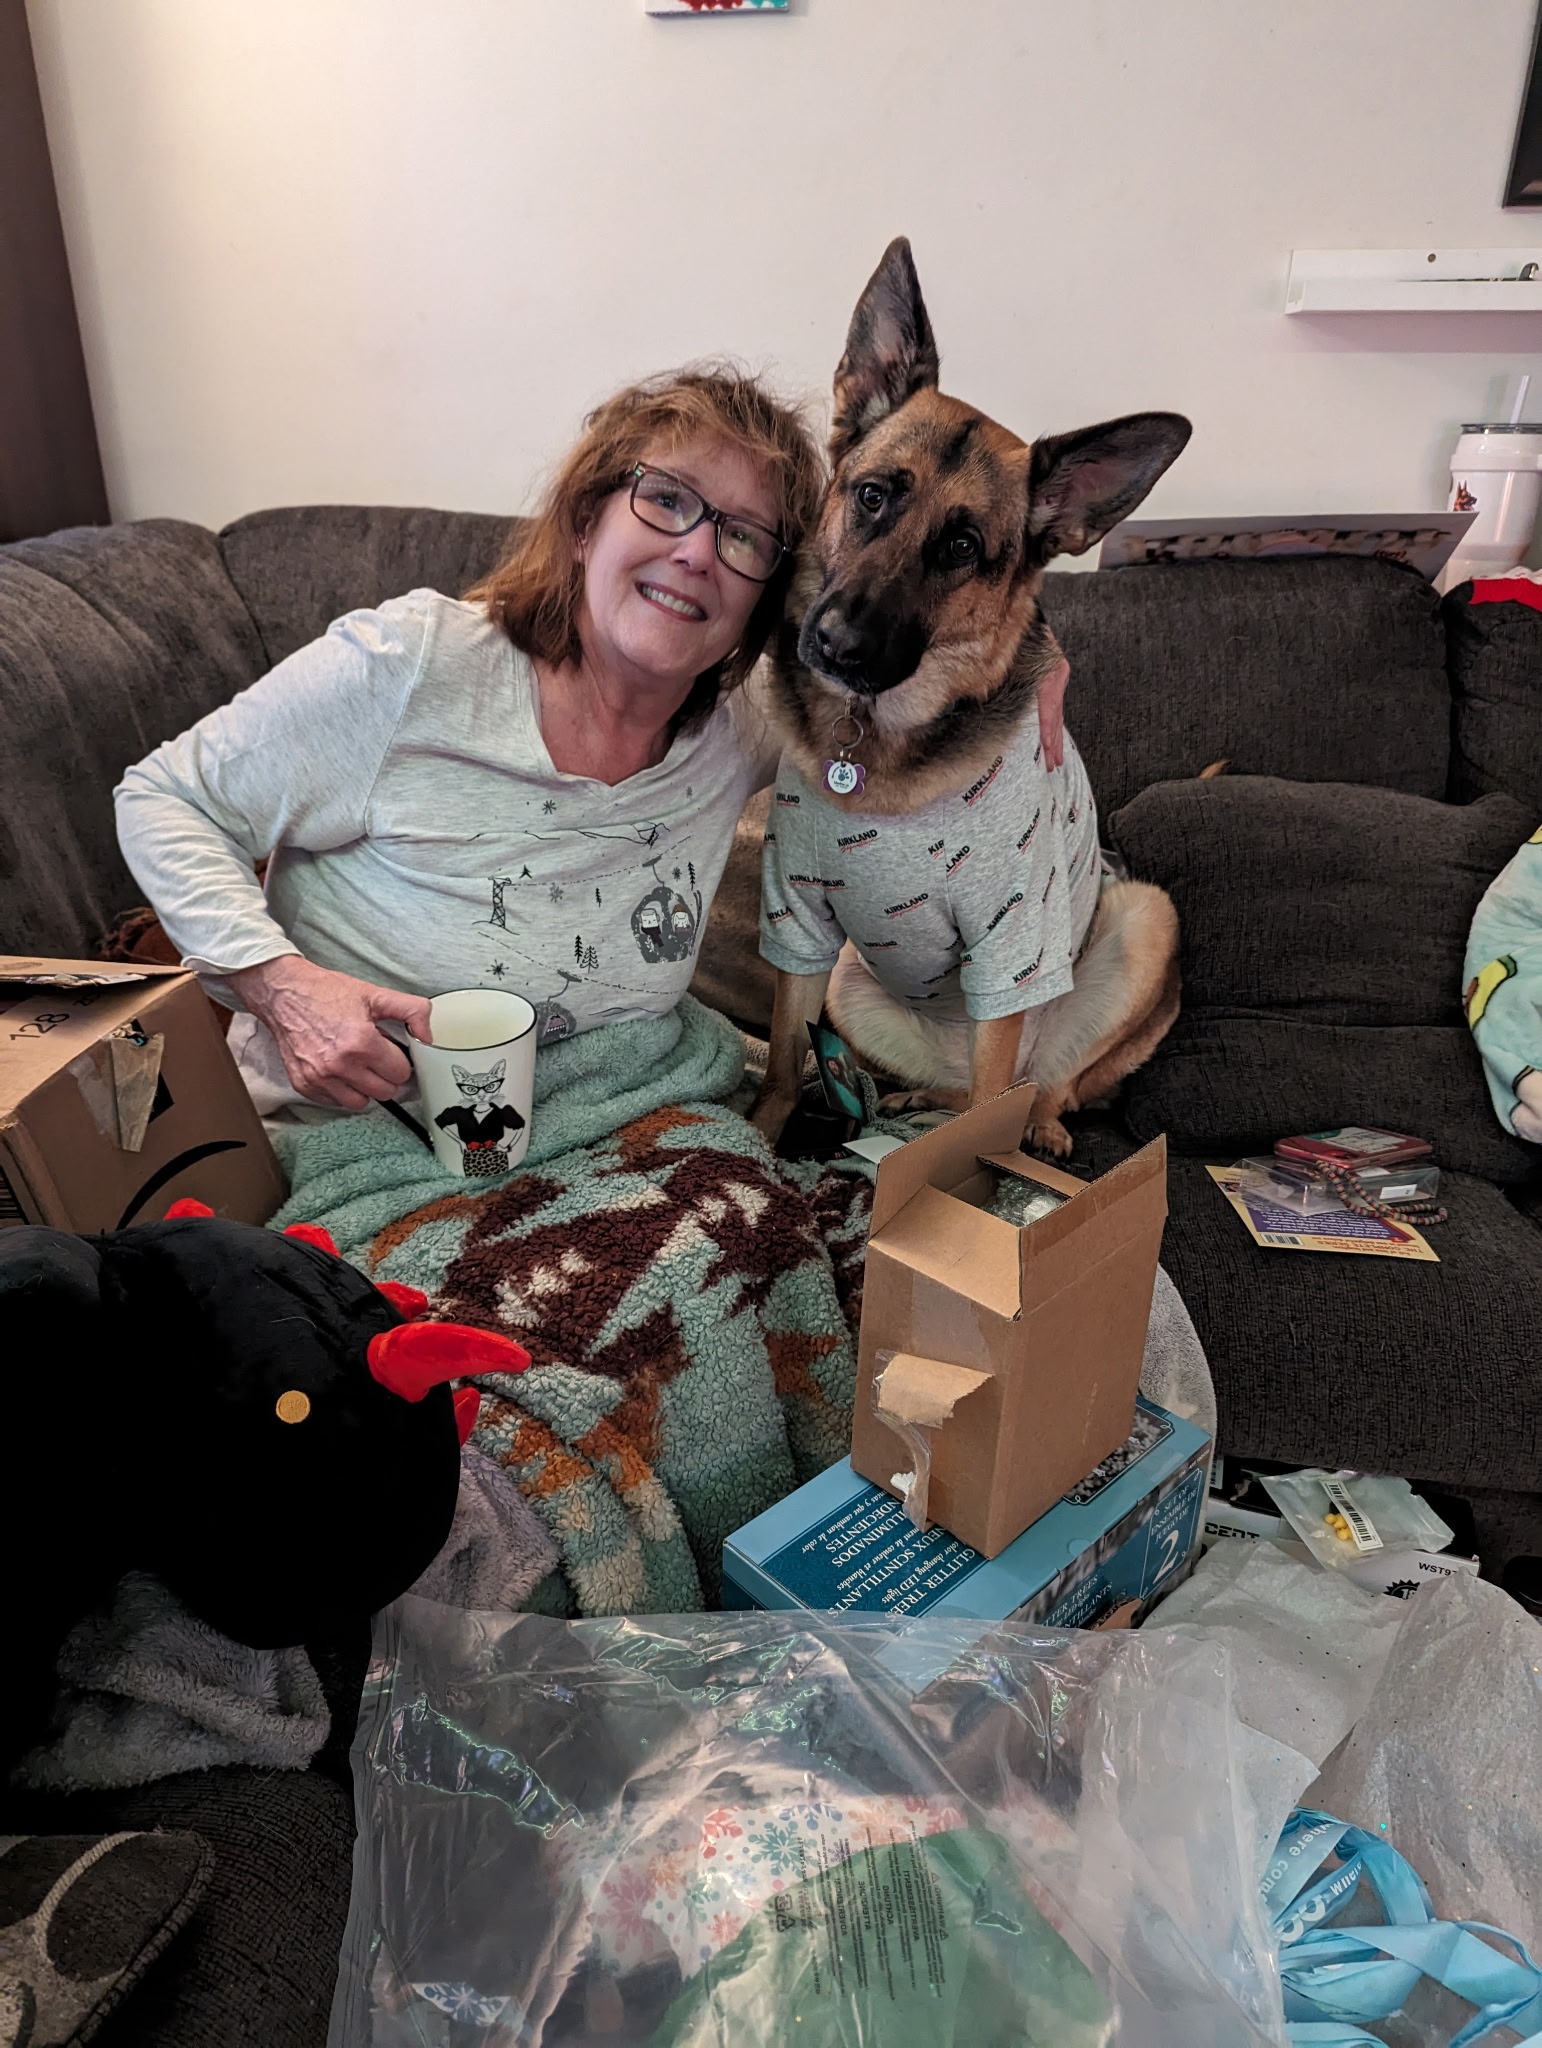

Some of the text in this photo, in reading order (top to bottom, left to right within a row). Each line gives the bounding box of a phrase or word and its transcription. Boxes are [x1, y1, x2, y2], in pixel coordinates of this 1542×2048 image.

[962, 756, 1003, 802] KIRKLAND
[836, 829, 878, 847] KIRKLAND
[946, 845, 971, 873] LAND
[884, 892, 929, 915] KIRKLAND
[986, 892, 1024, 931] KIRKLAND
[1012, 947, 1044, 983] KIRKL
[9, 1012, 71, 1041] 128
[853, 1503, 865, 1515] que
[1151, 1487, 1198, 1536] ENSEMBLE DE
[1163, 1484, 1190, 1513] SET OF
[818, 1532, 828, 1542] de
[826, 1514, 853, 1535] cambian
[1155, 1506, 1189, 1545] JUEGO DE
[801, 1540, 818, 1554] color
[872, 1545, 895, 1565] couleur
[894, 1540, 904, 1548] de
[1152, 1529, 1179, 1585] 2
[837, 1569, 867, 1591] blanches
[864, 1562, 872, 1571] et
[881, 1541, 959, 1604] color changing LED lights
[828, 1548, 916, 1618] SCINTILLANTS
[885, 1548, 975, 1622] GLITTER TREES
[1071, 1574, 1098, 1603] TREES
